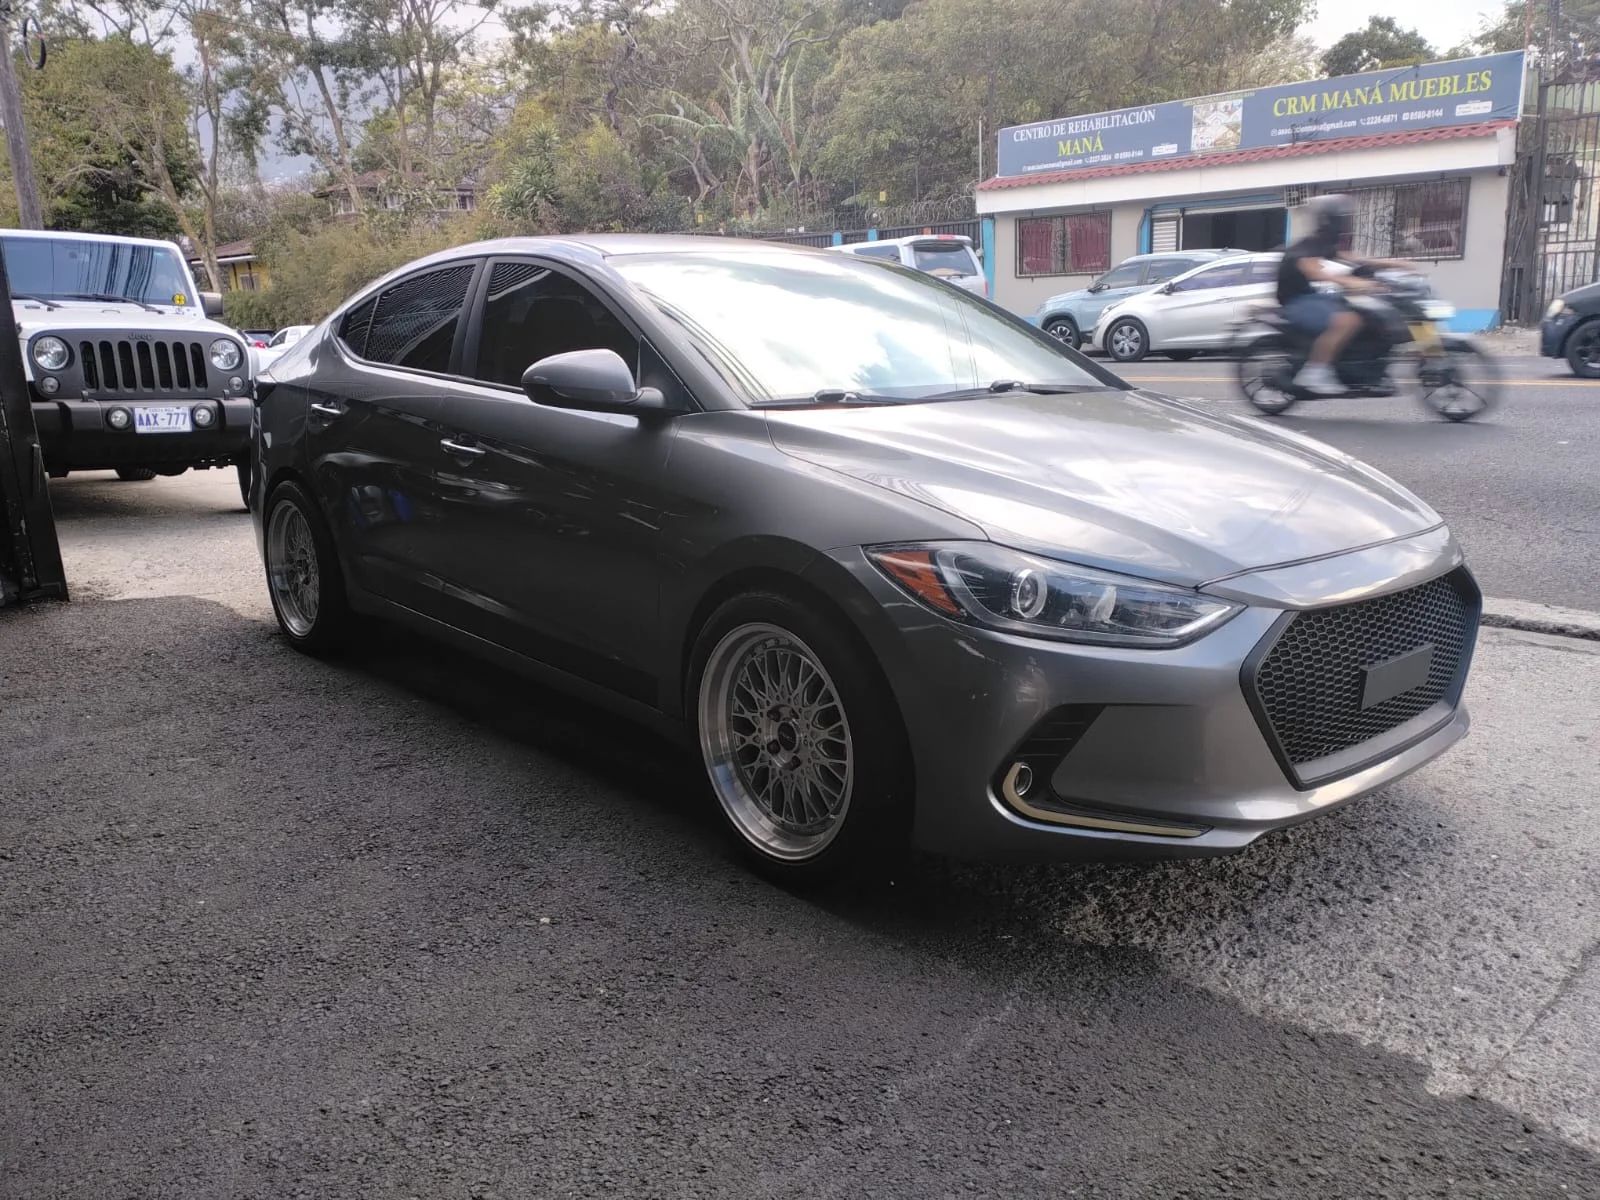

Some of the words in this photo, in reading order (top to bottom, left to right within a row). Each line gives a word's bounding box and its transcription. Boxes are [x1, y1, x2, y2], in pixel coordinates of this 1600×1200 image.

[1272, 94, 1317, 117] CRM
[1321, 80, 1384, 111] MANÁ
[1388, 70, 1492, 103] MUEBLES
[1013, 125, 1051, 142] CENTRO
[1053, 123, 1067, 137] DE
[1068, 108, 1156, 135] REHABILITACIÓN
[1057, 131, 1104, 156] MANÁ
[138, 412, 187, 426] AAX-777
